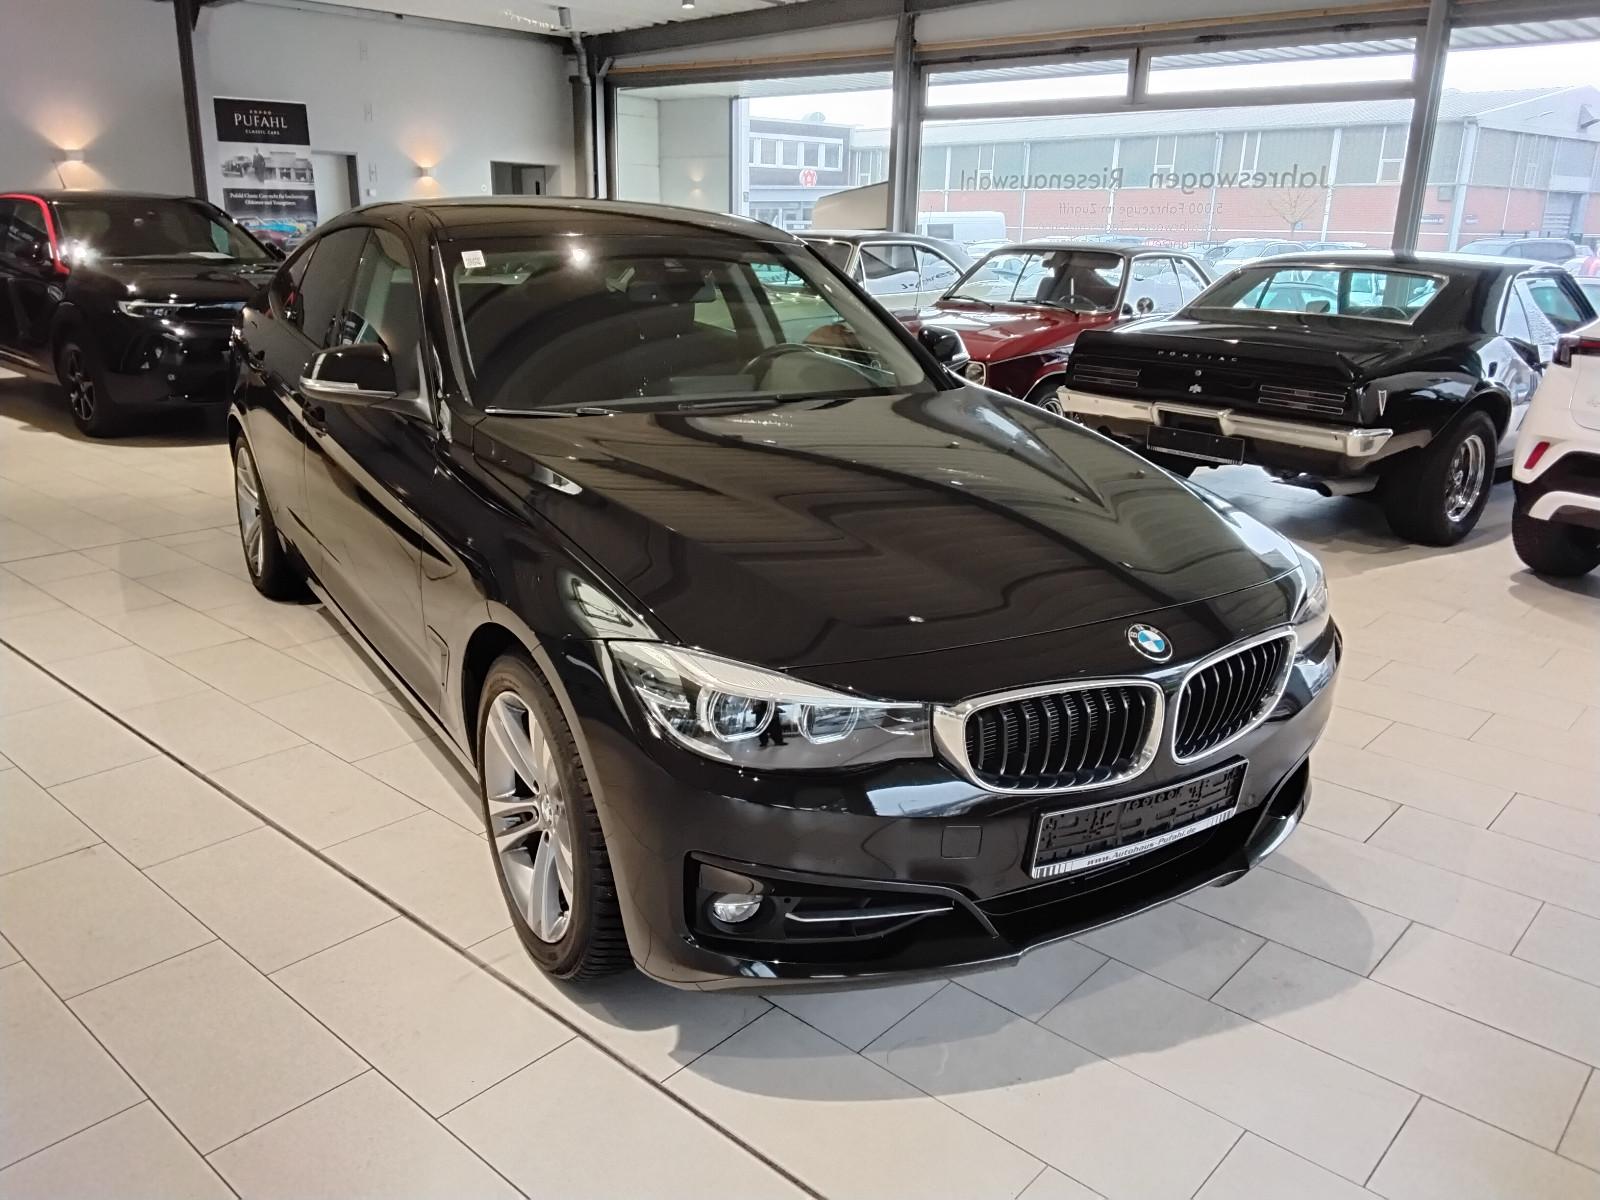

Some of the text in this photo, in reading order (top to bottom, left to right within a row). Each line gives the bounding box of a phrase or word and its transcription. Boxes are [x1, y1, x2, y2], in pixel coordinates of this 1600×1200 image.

[234, 112, 288, 129] PUFAHL
[1158, 350, 1237, 362] PONTIAC
[1086, 826, 1197, 866] www.Autohaus-Pufahl.de
